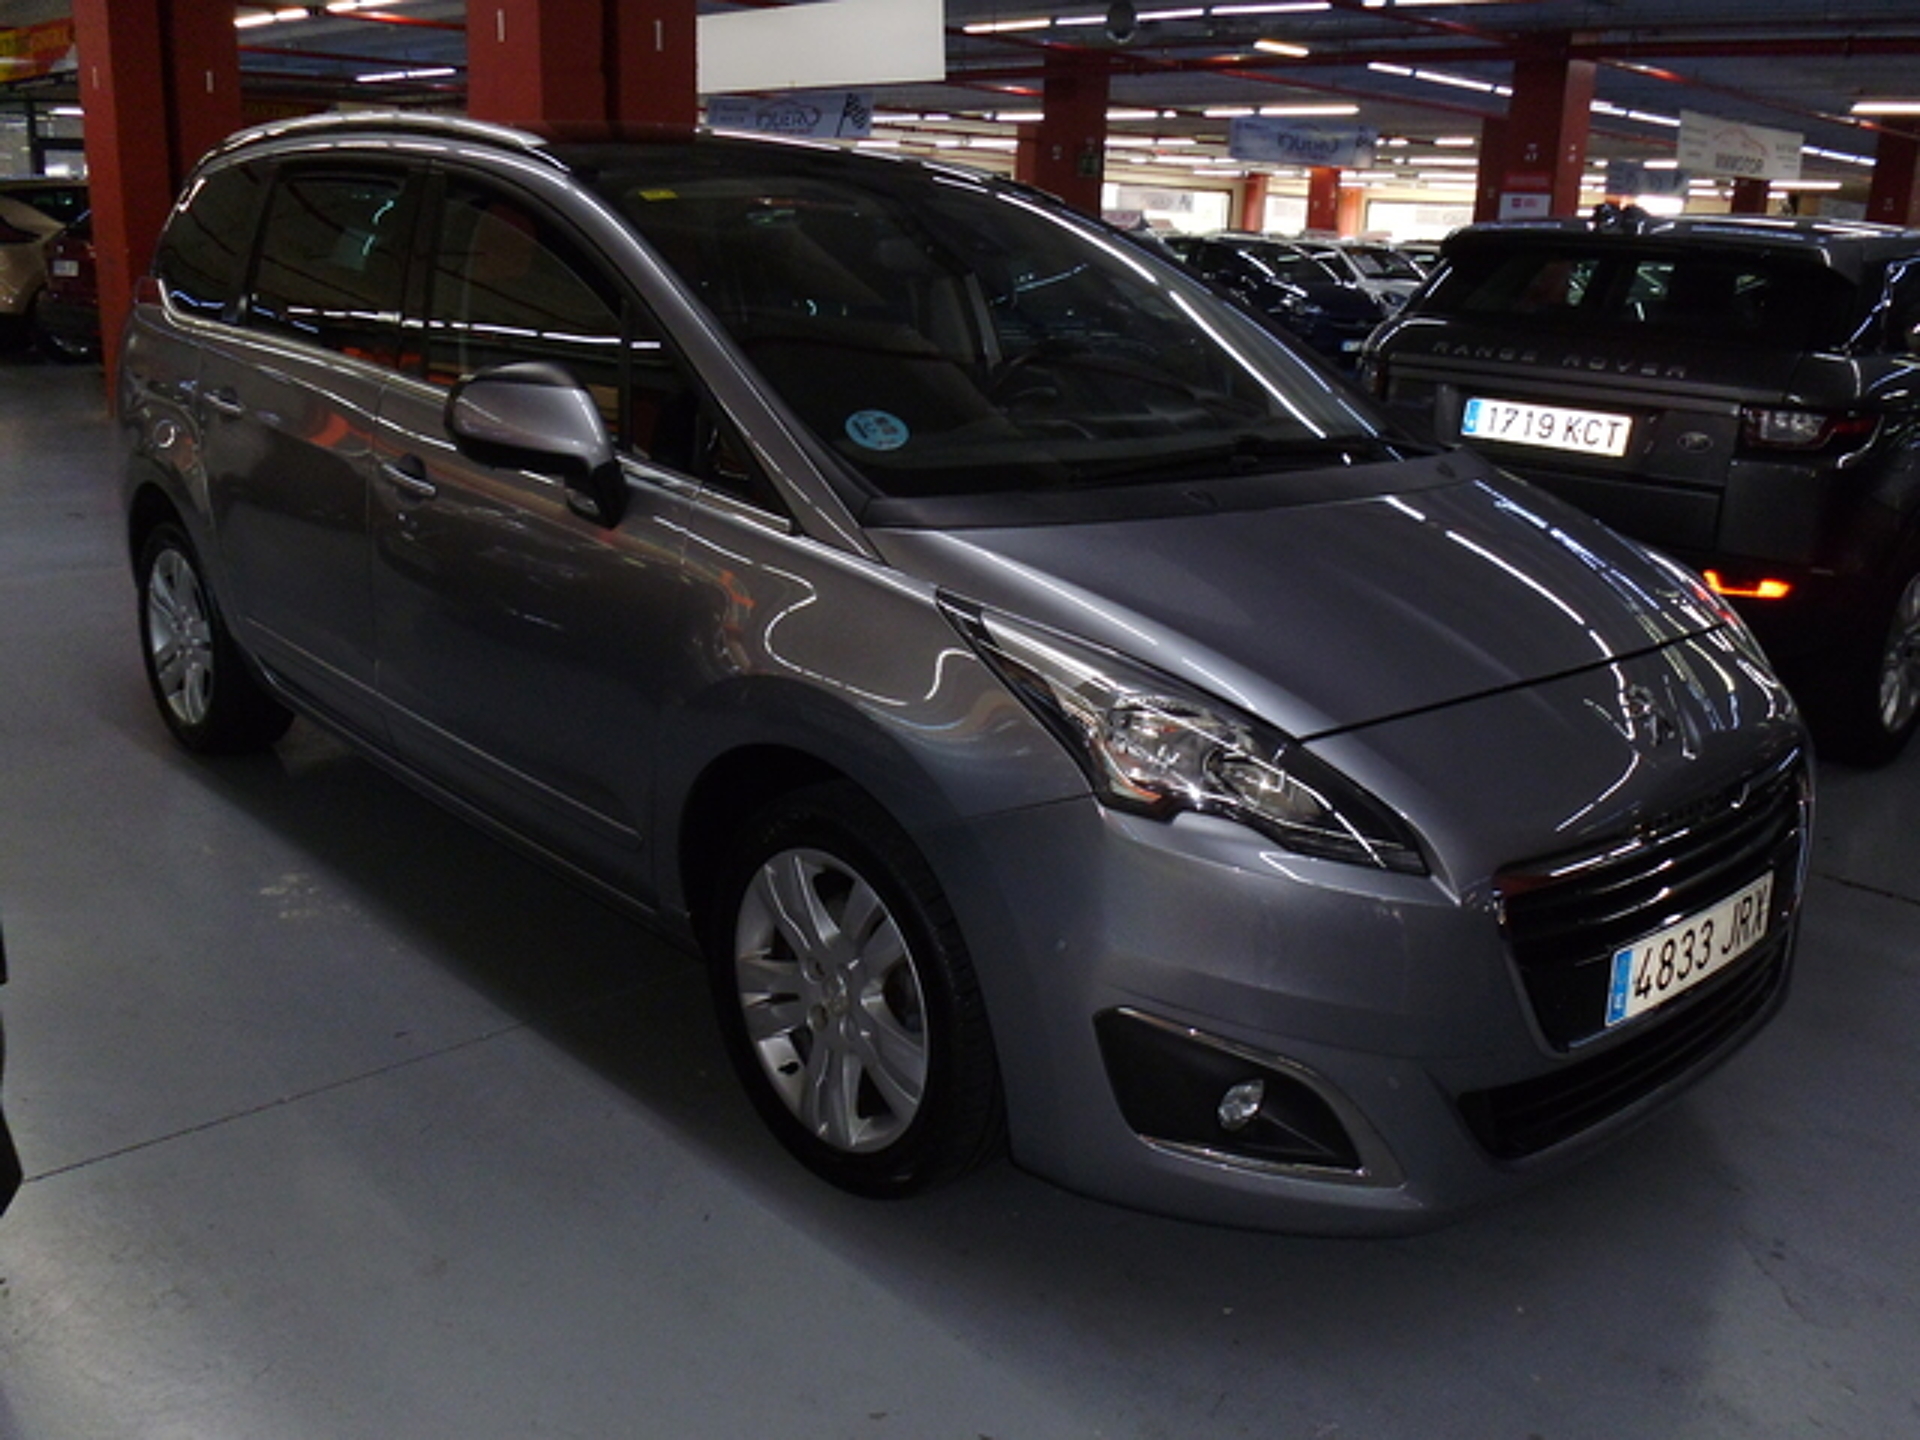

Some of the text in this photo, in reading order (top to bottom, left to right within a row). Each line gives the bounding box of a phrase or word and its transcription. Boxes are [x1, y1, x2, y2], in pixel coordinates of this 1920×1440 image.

[1432, 341, 1686, 378] RANGE ROVER
[1486, 406, 1623, 448] 1719 KCT
[1634, 884, 1768, 999] 4833 JRX
